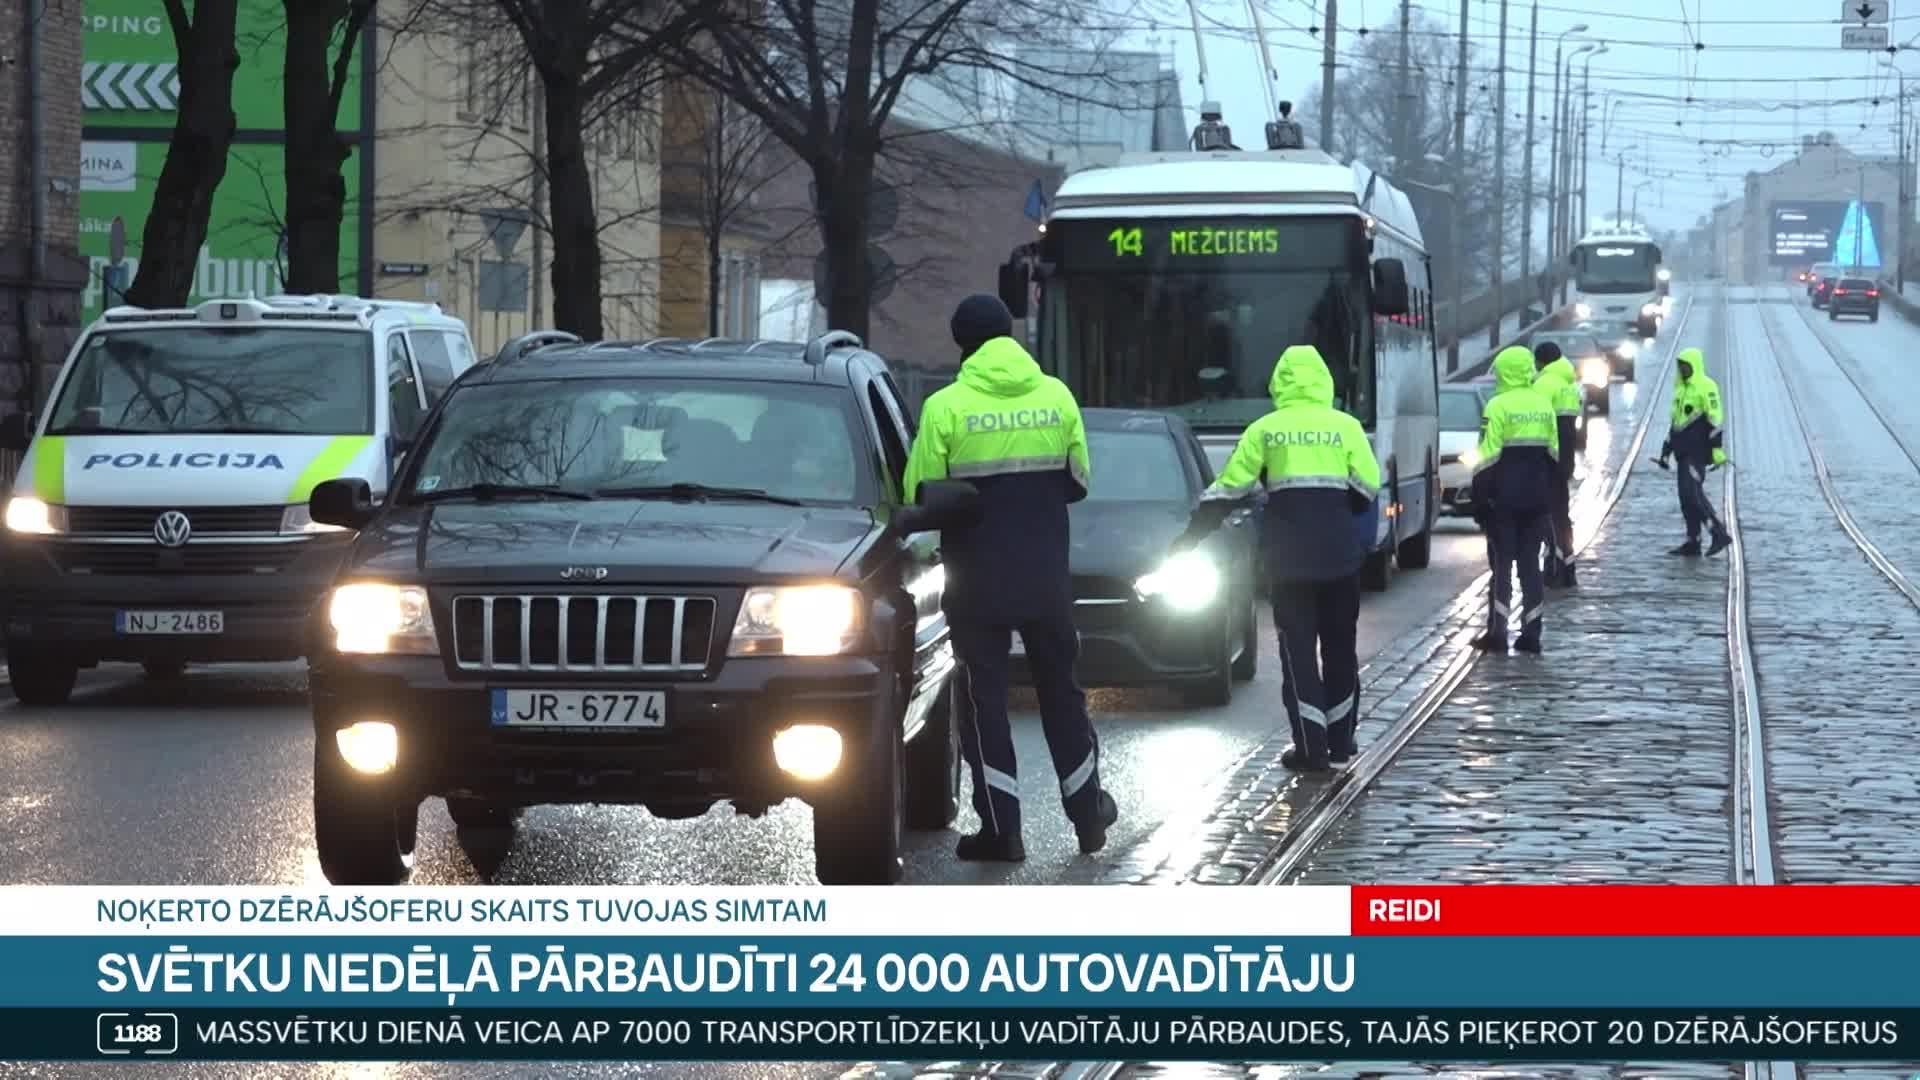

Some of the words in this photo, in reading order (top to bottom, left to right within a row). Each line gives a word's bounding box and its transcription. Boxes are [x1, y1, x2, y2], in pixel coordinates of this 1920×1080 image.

[1108, 227, 1143, 256] 14
[1171, 227, 1279, 255] MEŽCIEMS
[966, 408, 1062, 432] POLICIJA
[1264, 431, 1344, 447] POLICIJA
[83, 452, 285, 470] POLICIJA
[560, 566, 608, 579] Jeep
[130, 614, 220, 632] NJ-2486
[516, 693, 660, 723] JR-6774
